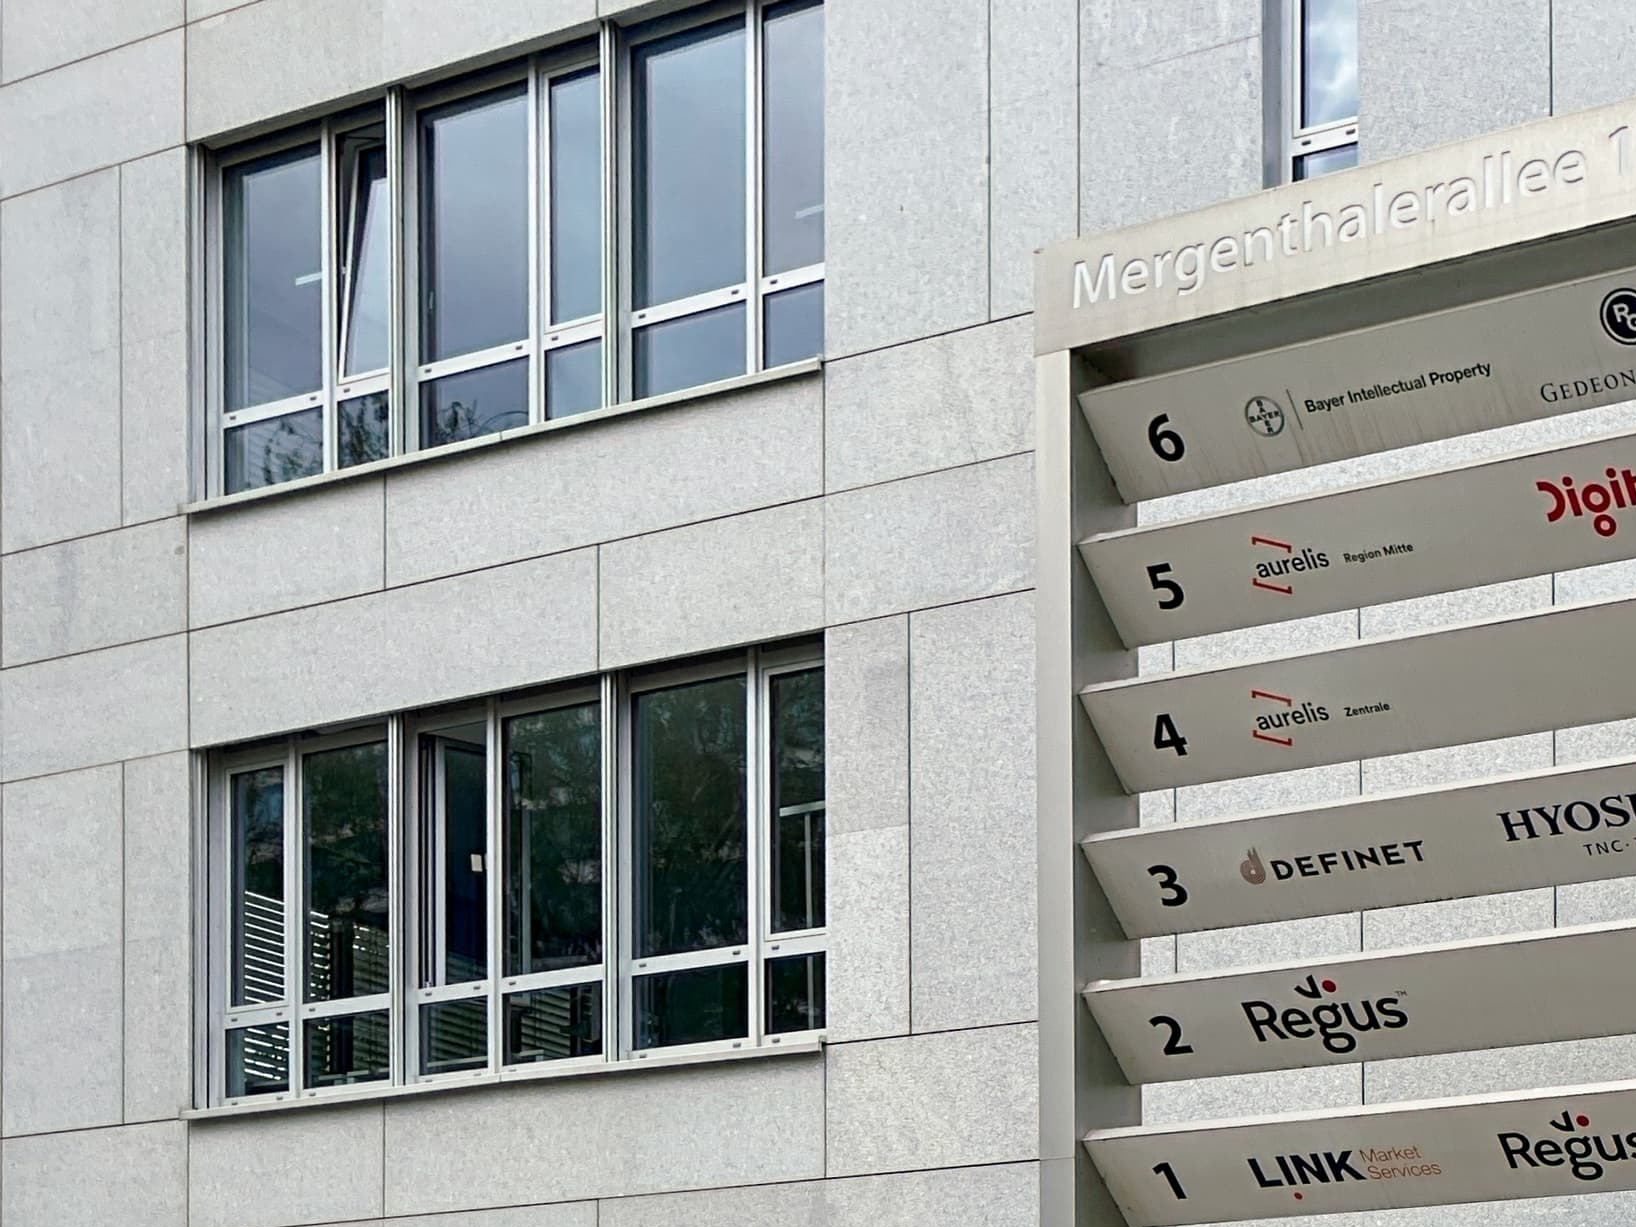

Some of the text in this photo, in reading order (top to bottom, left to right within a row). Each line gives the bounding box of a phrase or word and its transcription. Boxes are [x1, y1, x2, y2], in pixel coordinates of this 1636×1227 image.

[1072, 150, 1586, 309] Mergenthalerallee
[1304, 362, 1491, 413] Bayer Intellectual Property
[1540, 369, 1636, 403] GEDEON
[1148, 413, 1185, 463] 6
[1256, 548, 1330, 579] aurelis
[1343, 542, 1414, 564] Region Mitte
[1146, 562, 1185, 610] 5
[1256, 701, 1330, 731] aurelis
[1344, 702, 1391, 718] Zentrale
[1153, 713, 1188, 757] 4
[1270, 840, 1424, 881] DEFINET
[1147, 864, 1188, 907] 3
[1149, 1015, 1195, 1056] 2
[1241, 997, 1409, 1054] Regus
[1247, 1149, 1367, 1188] LINK
[1359, 1145, 1422, 1163] Market
[1367, 1162, 1443, 1180] Services
[1152, 1162, 1187, 1200] 1
